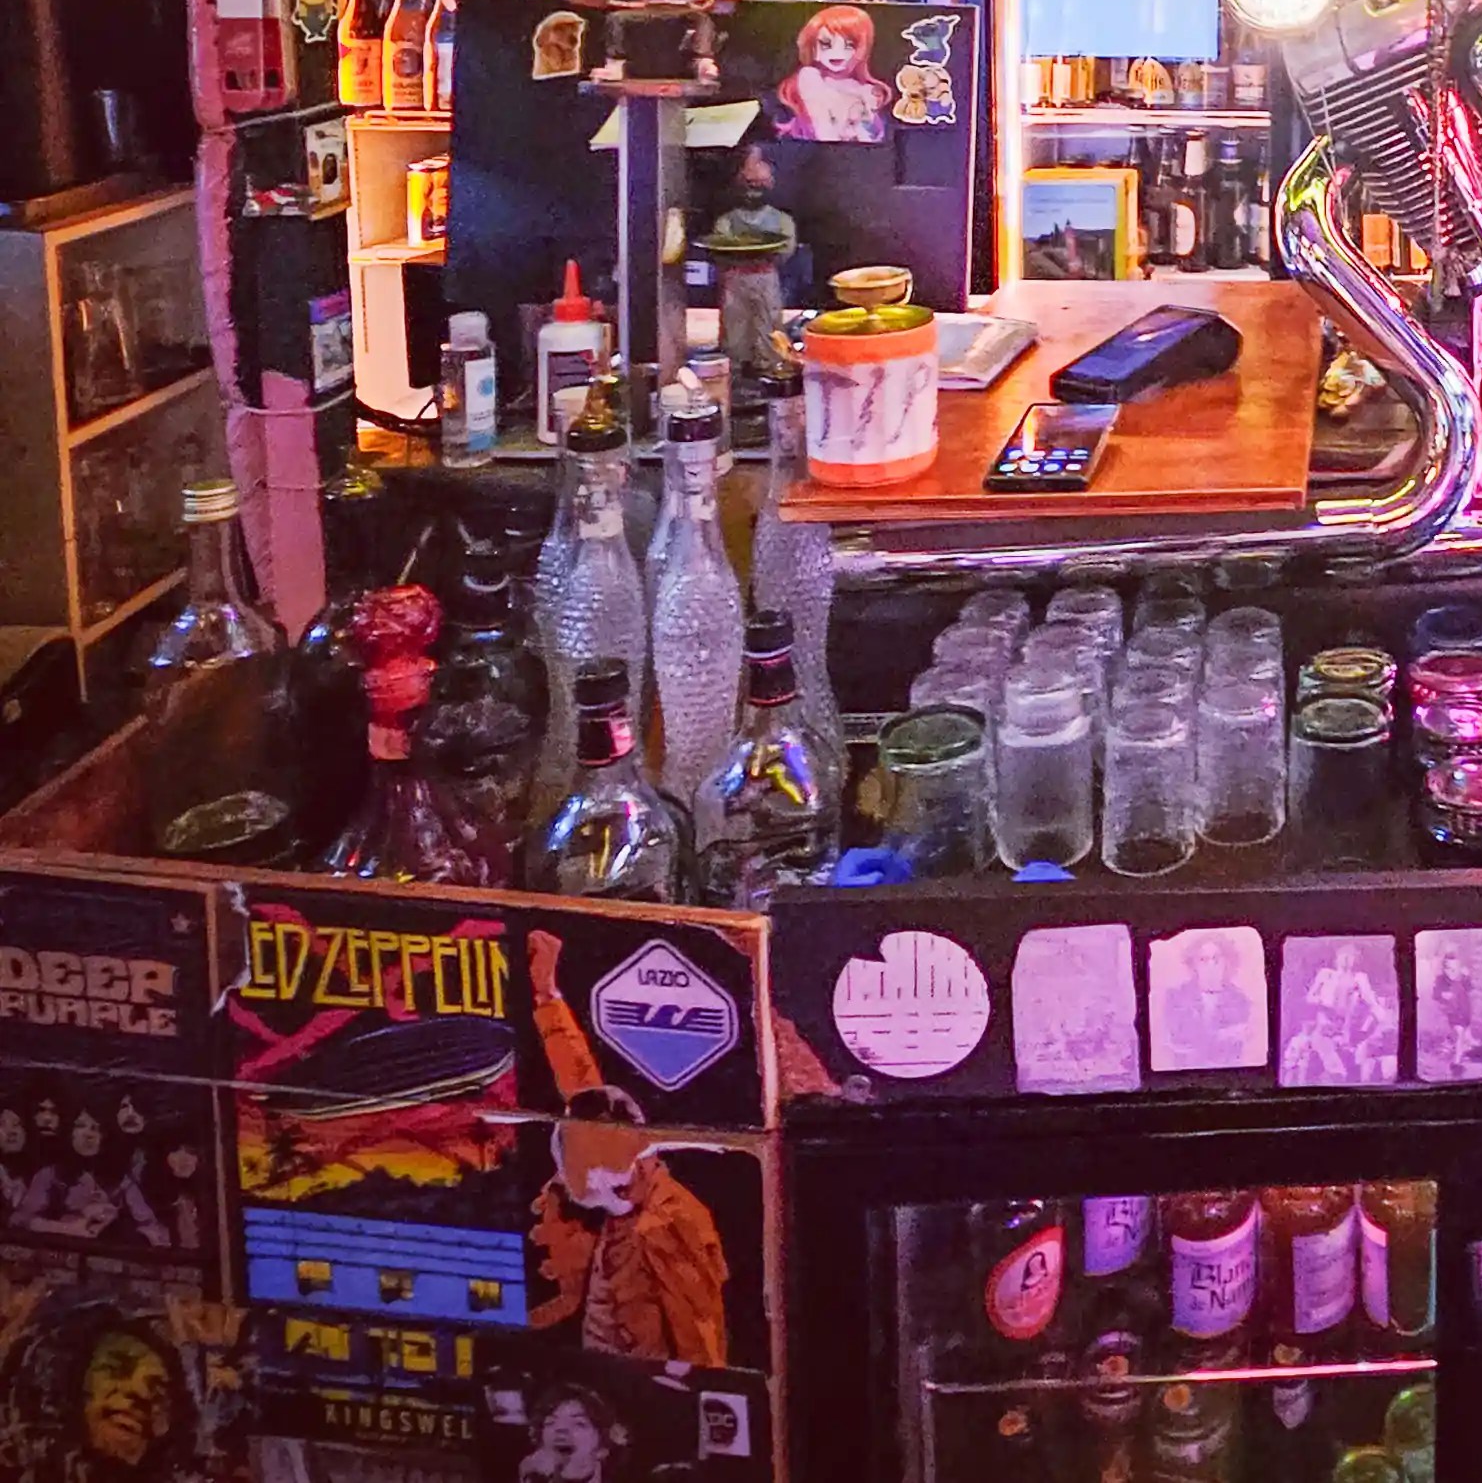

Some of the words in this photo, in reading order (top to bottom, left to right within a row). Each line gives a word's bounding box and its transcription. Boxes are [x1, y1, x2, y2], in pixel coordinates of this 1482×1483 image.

[0, 944, 176, 1004] DEEP
[312, 924, 510, 1020] ZEPPELIN
[637, 967, 691, 988] LAZIO
[0, 990, 177, 1037] PURPLE
